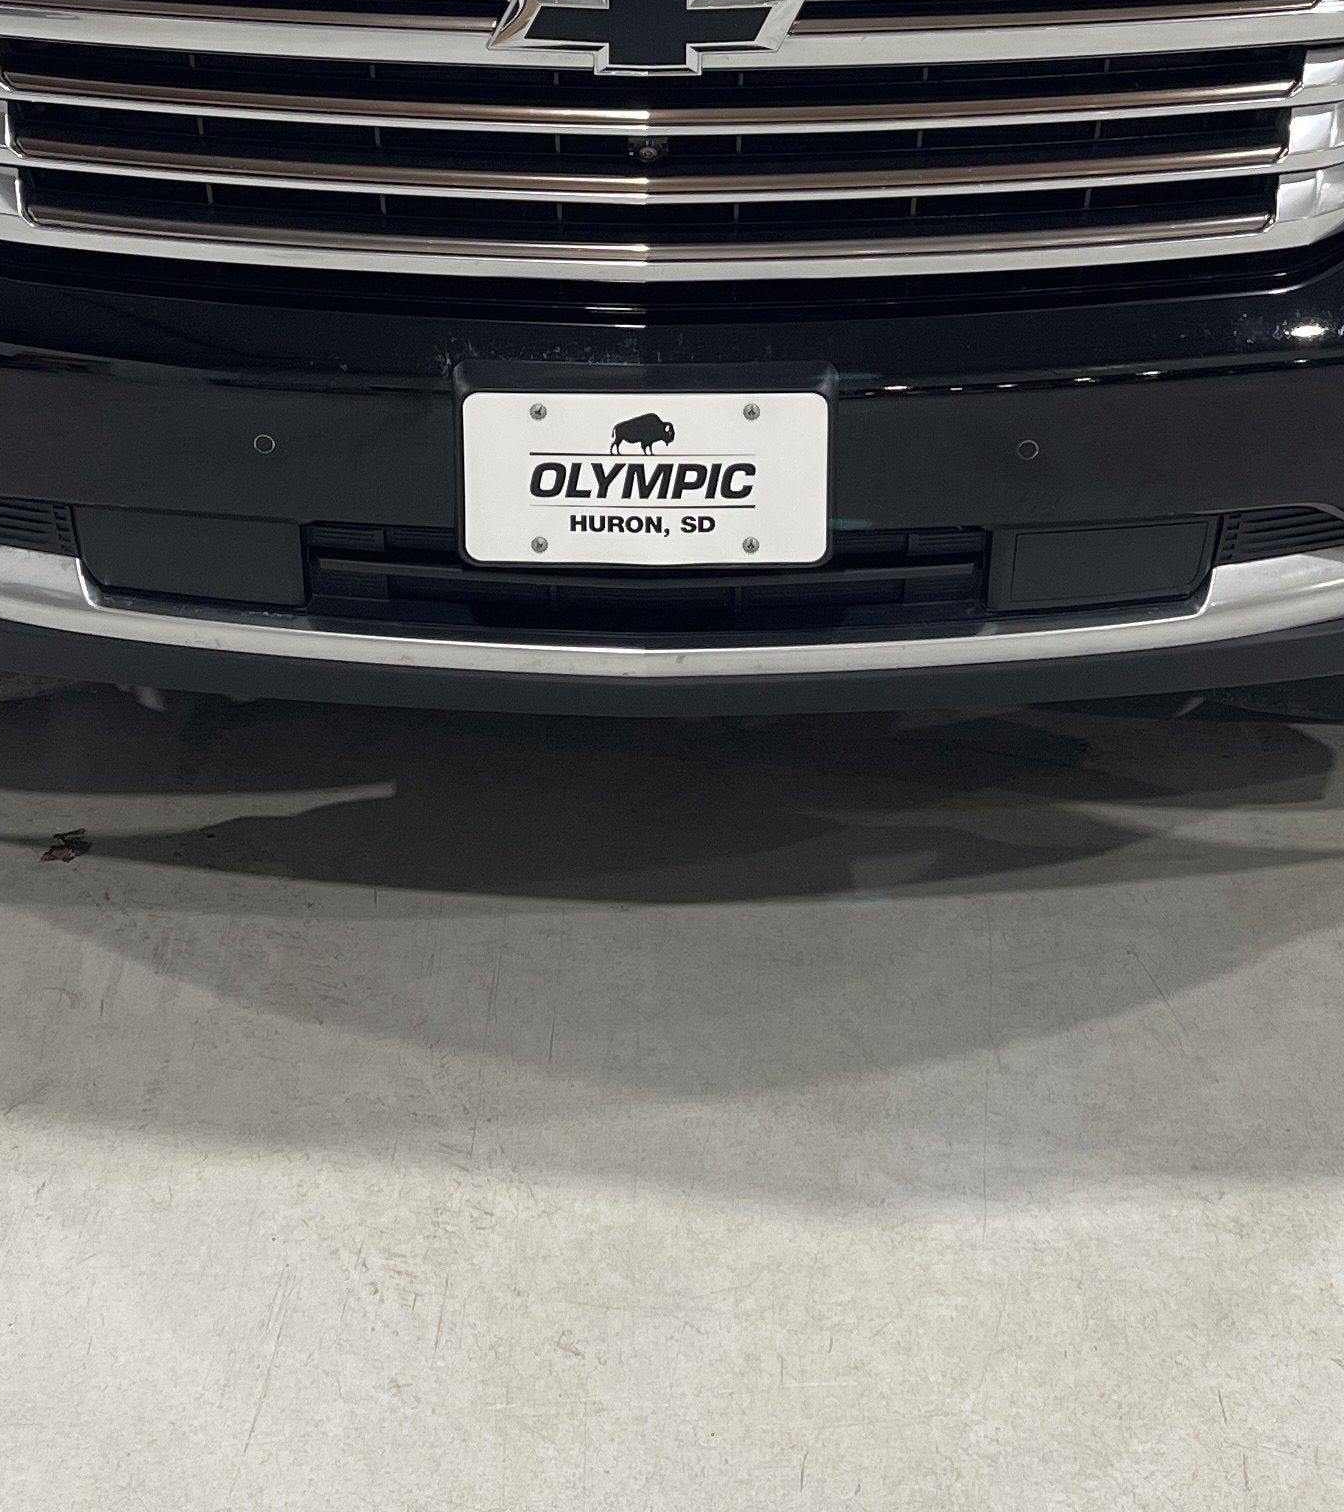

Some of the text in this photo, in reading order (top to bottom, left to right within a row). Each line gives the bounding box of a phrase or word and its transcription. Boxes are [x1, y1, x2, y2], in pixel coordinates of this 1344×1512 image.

[530, 462, 756, 499] OLYMPIC
[570, 515, 716, 537] HURON, SD
